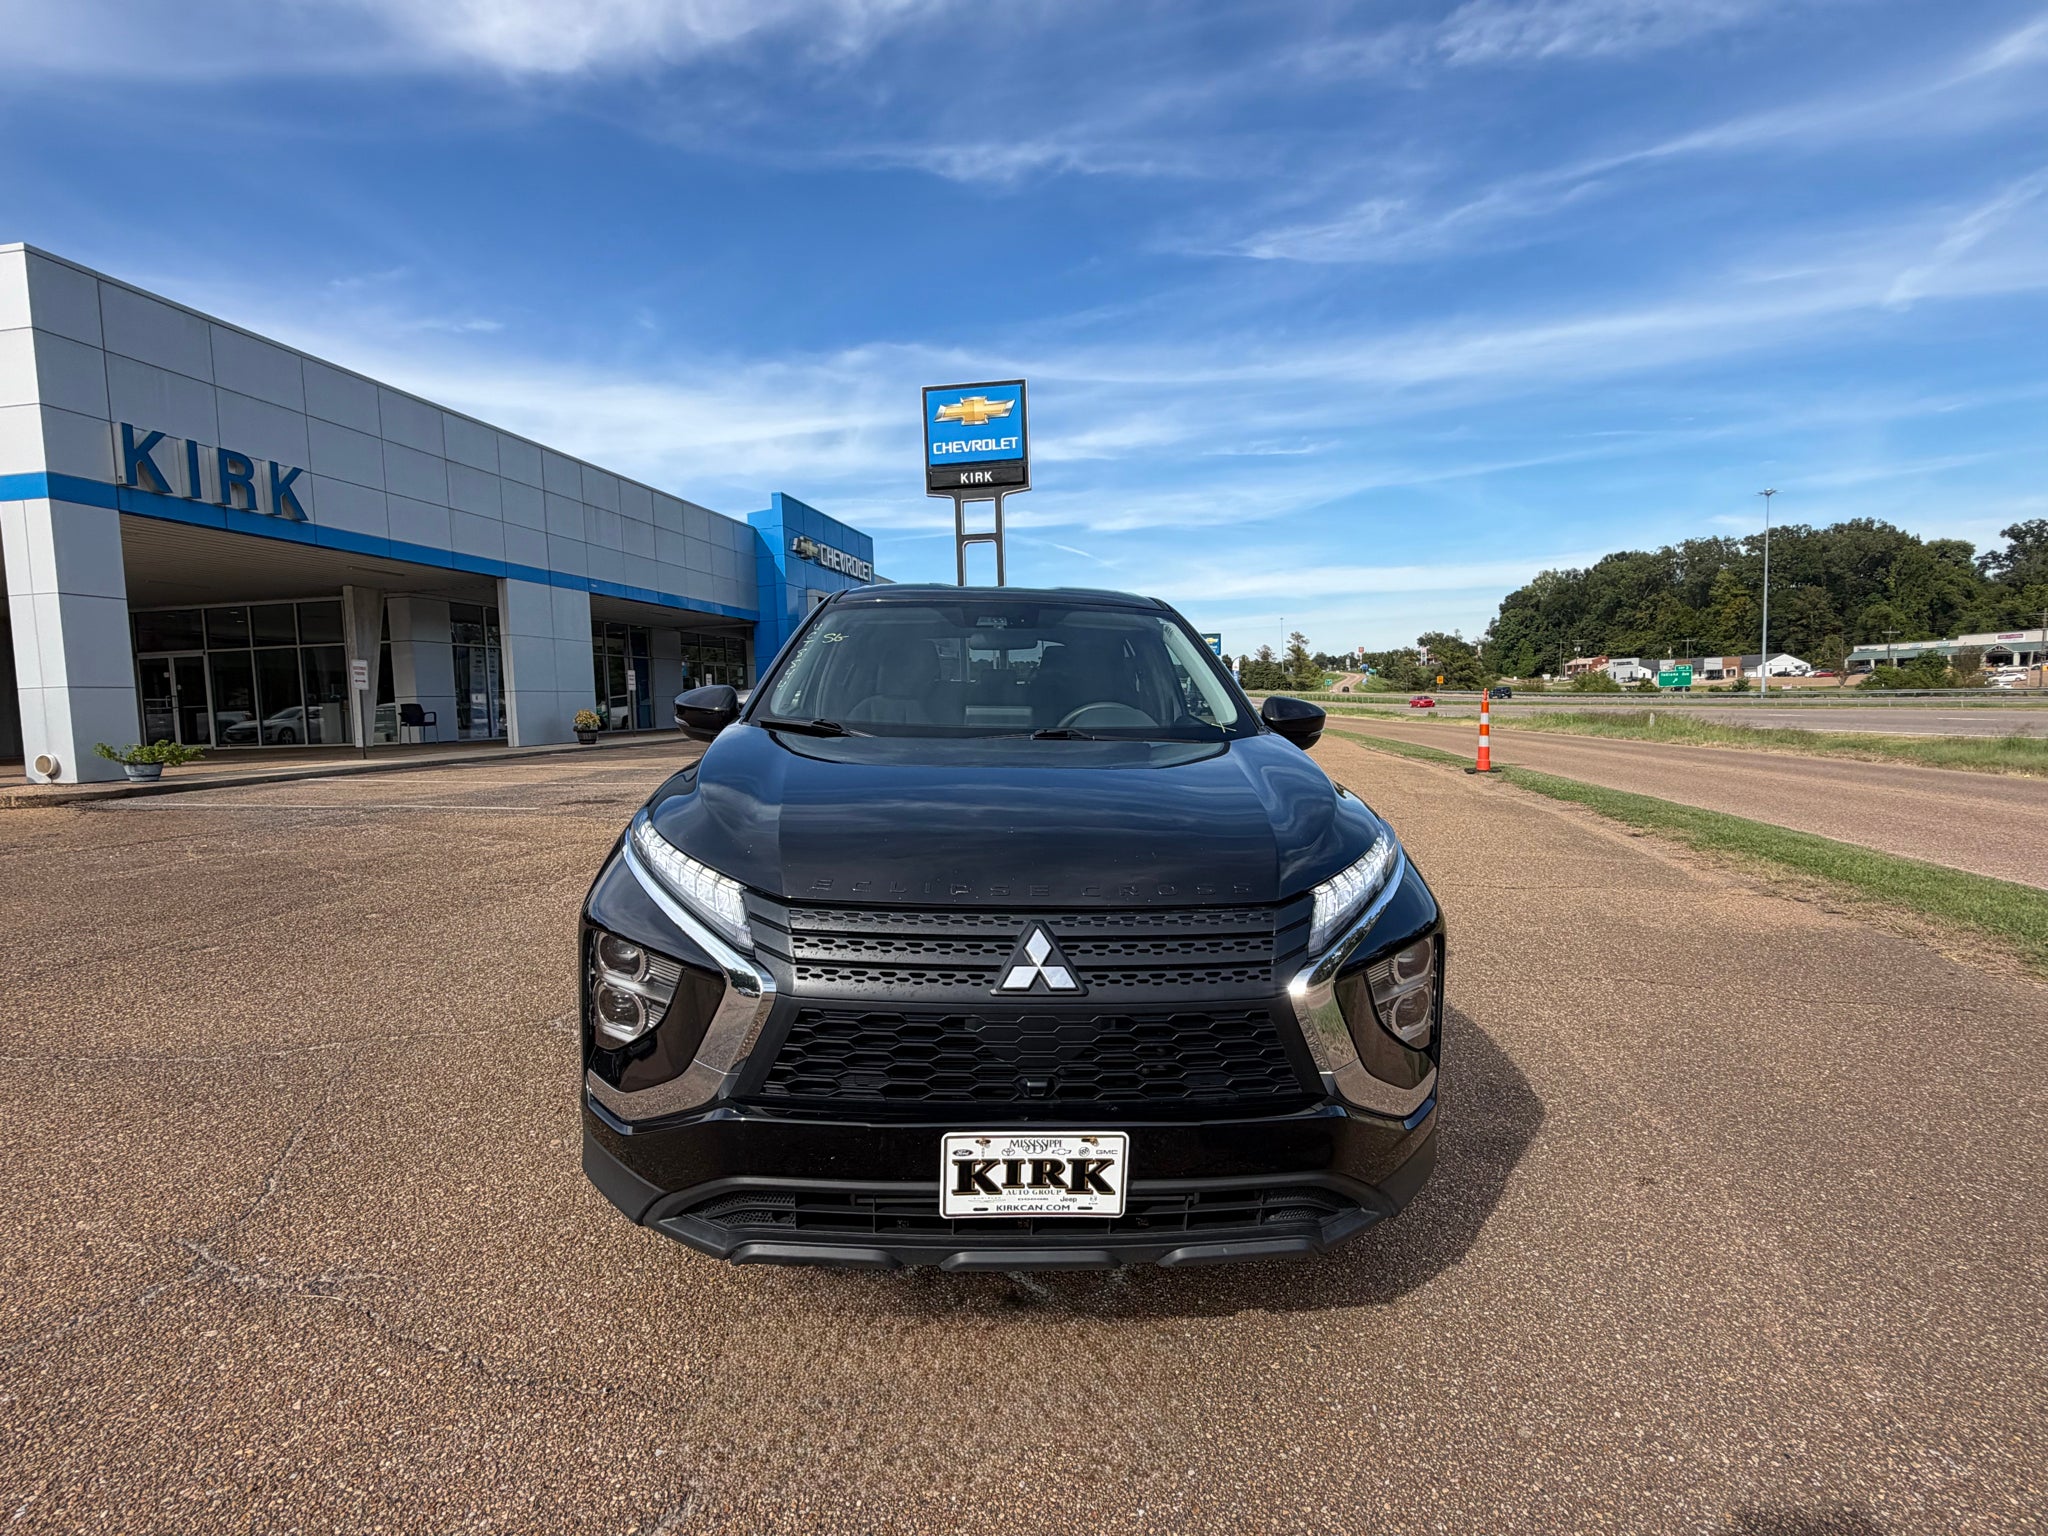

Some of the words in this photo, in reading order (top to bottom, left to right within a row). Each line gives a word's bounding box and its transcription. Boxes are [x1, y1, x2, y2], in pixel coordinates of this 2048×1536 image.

[933, 436, 1018, 455] CHEVROLET
[119, 422, 309, 522] KIRK
[960, 471, 993, 484] KIRK
[819, 543, 872, 582] CHEVROLET
[811, 879, 1050, 897] ECLIPSE
[1081, 883, 1253, 897] CROSS
[1009, 1139, 1062, 1154] MISSISSIPPI
[952, 1158, 1116, 1195] KIRK
[996, 1204, 1070, 1212] KIRKCAN.COM
